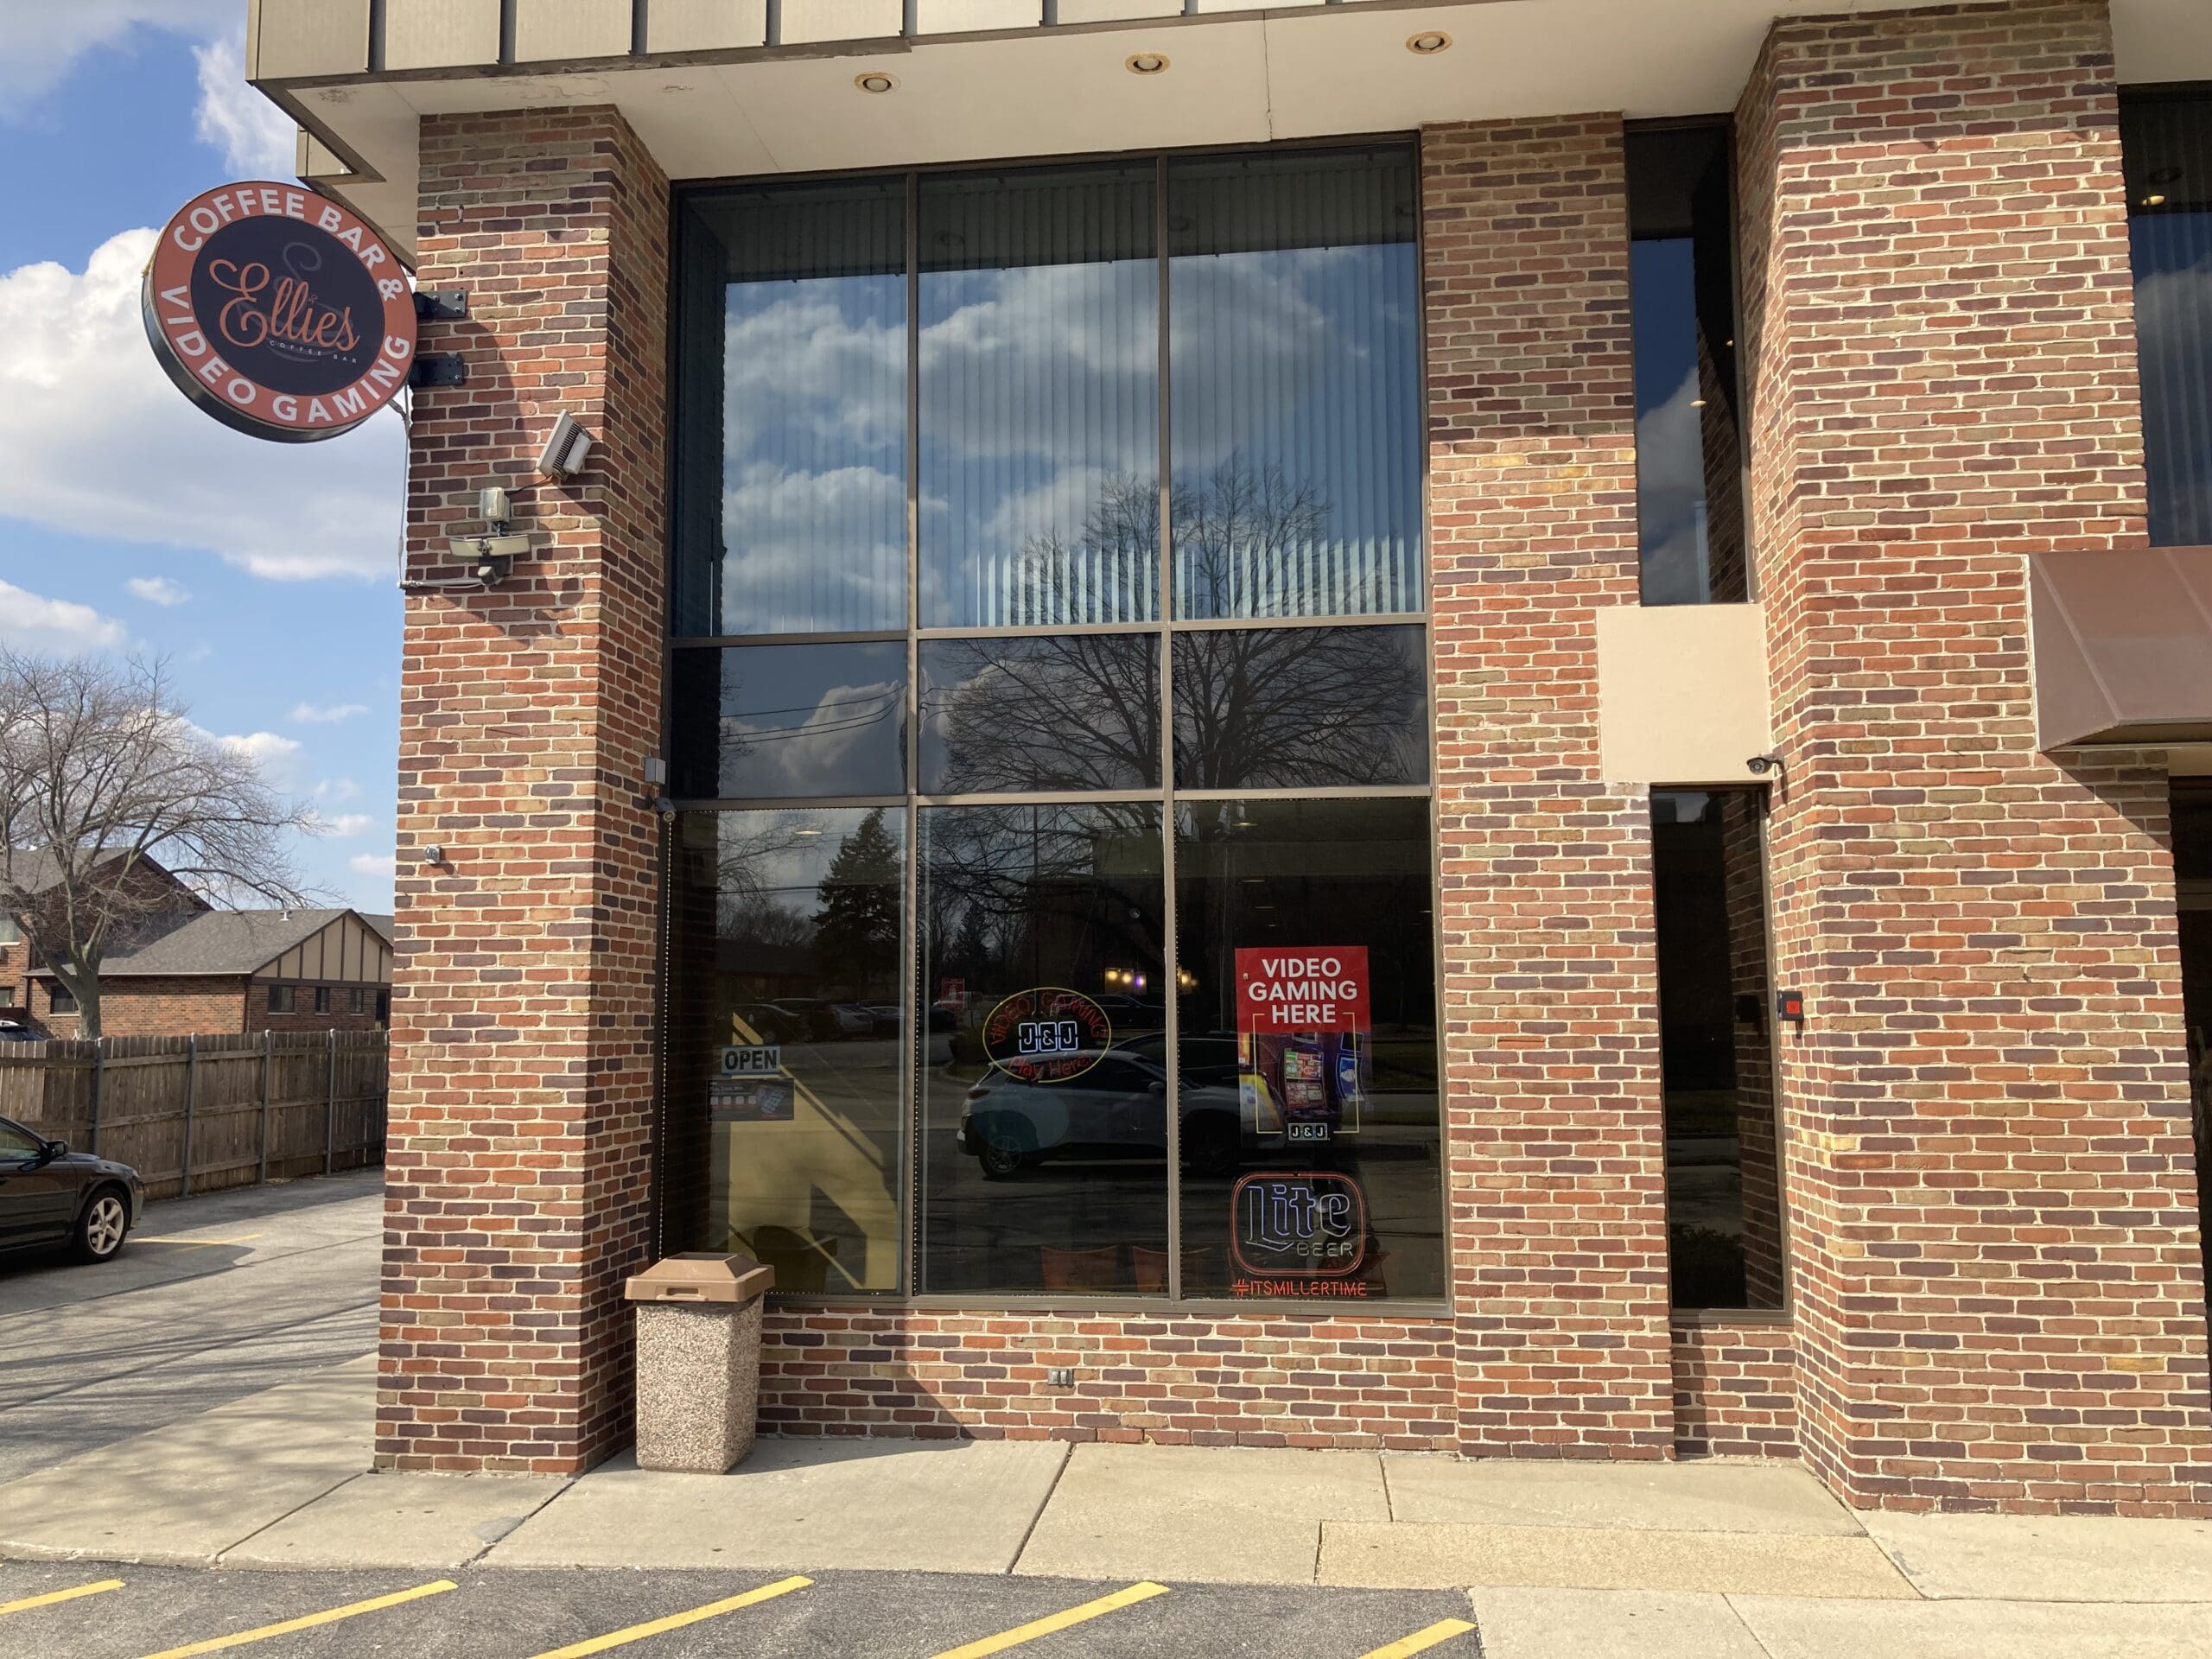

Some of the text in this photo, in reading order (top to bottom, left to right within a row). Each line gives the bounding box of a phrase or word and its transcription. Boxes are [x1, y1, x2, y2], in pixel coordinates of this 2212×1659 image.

[173, 188, 404, 302] COFFEE BAR &
[161, 285, 410, 423] VIDEO GAMING
[270, 340, 357, 364] COFFEE BAR
[1262, 957, 1341, 978] VIDEO
[1248, 980, 1357, 1001] GAMING
[990, 991, 1108, 1045] VIDEO GAMING
[1272, 1003, 1337, 1024] HERE
[724, 1050, 777, 1070] OPEN
[1008, 1057, 1044, 1082] Play
[1245, 1184, 1351, 1251] Lite
[1296, 1242, 1354, 1257] BEER
[1231, 1279, 1368, 1296] #ITSMILLERTIME
